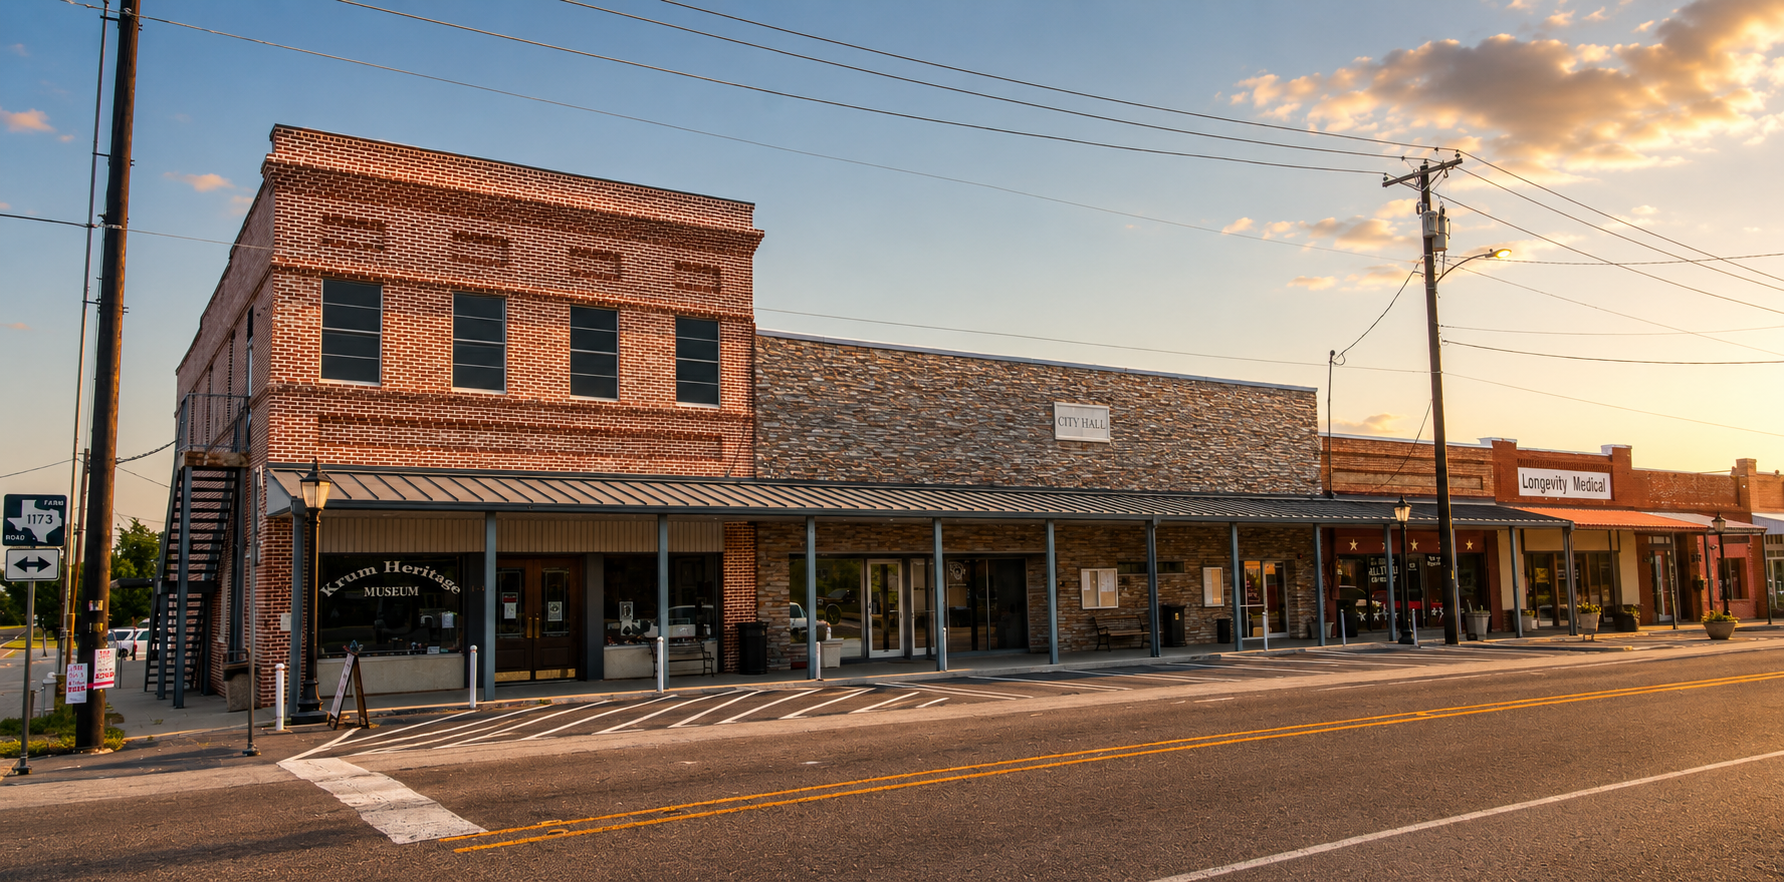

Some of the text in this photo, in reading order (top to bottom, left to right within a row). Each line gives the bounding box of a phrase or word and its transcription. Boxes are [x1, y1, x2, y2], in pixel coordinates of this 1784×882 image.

[1058, 416, 1106, 430] CITY HALL
[1522, 473, 1606, 495] Longevity Medical
[27, 513, 53, 525] 1173
[319, 560, 461, 598] Krum Heritage
[364, 586, 420, 597] MUSEUM
